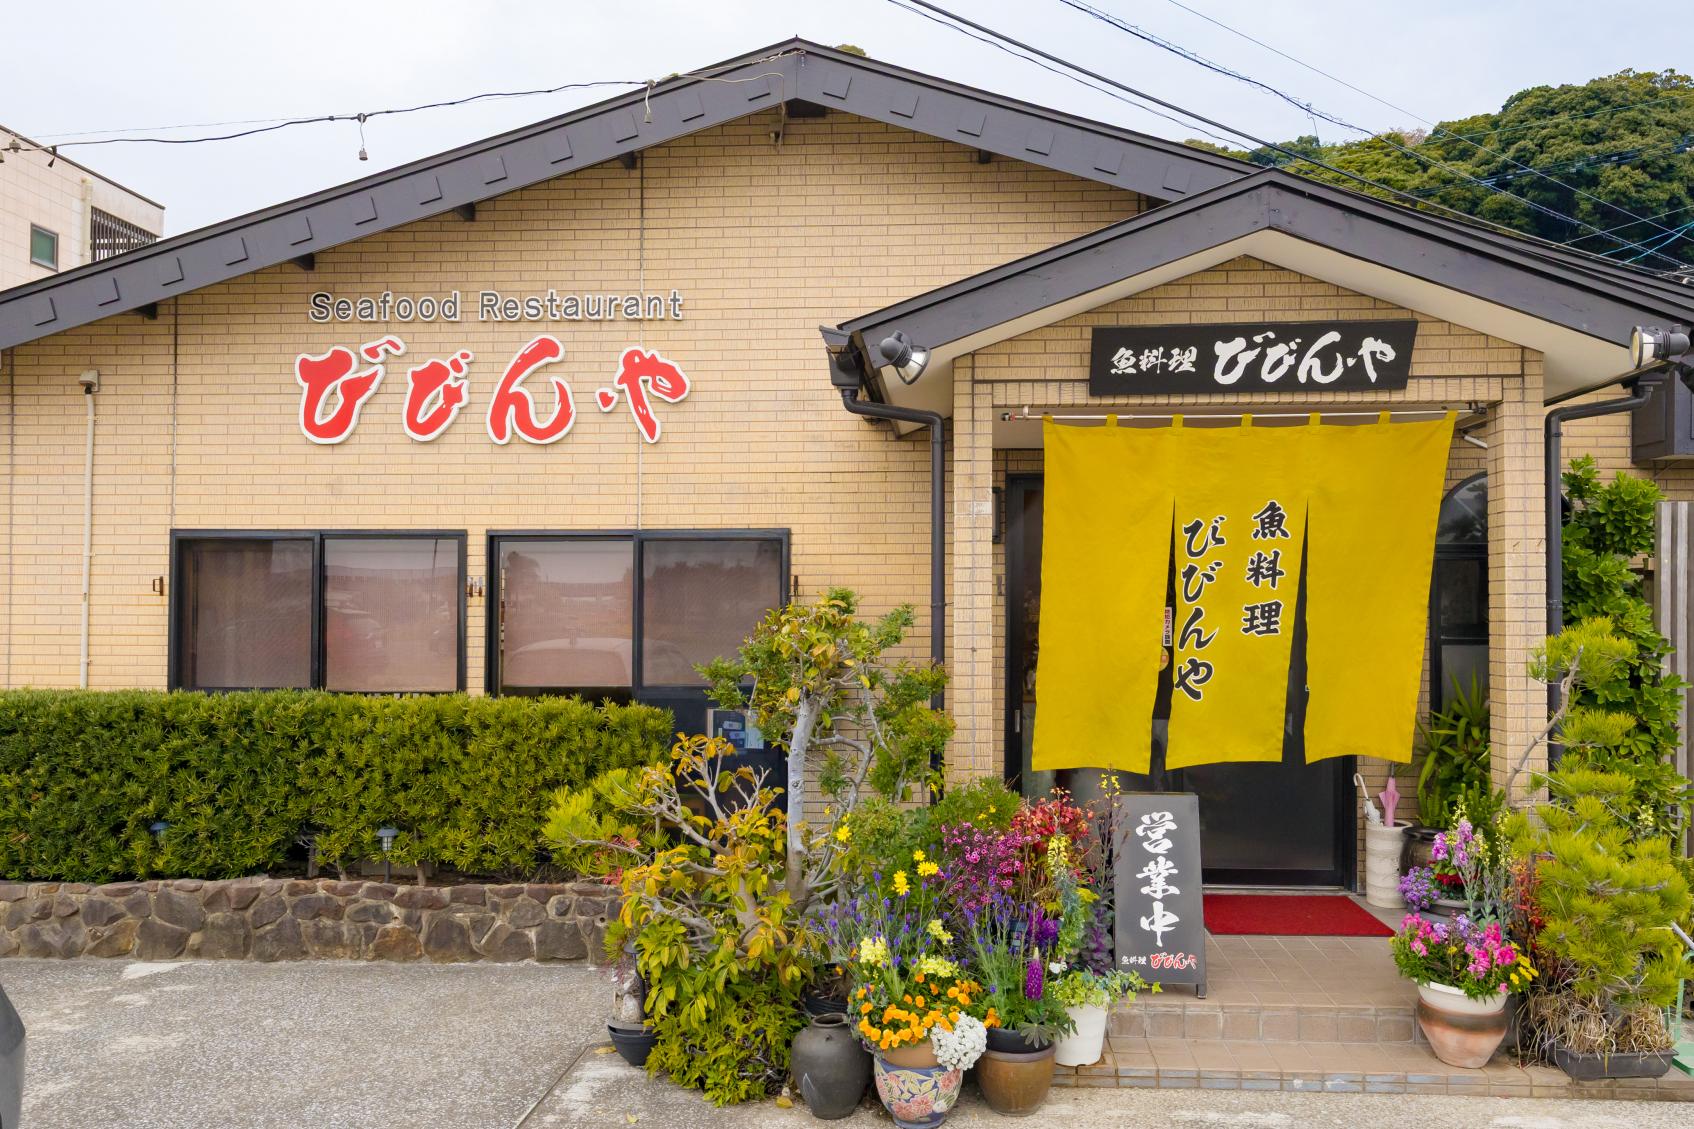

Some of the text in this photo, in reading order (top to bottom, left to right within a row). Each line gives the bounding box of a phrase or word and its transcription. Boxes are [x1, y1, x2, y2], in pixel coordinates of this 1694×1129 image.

[310, 290, 683, 321] Seafood Restaurant
[1110, 331, 1397, 385] 魚料理 びびんや
[295, 335, 691, 445] びびんや
[1174, 514, 1228, 701] びびんや
[1240, 499, 1291, 636] 魚料理
[1135, 811, 1181, 948] 営業中
[1150, 951, 1198, 970] びびんや
